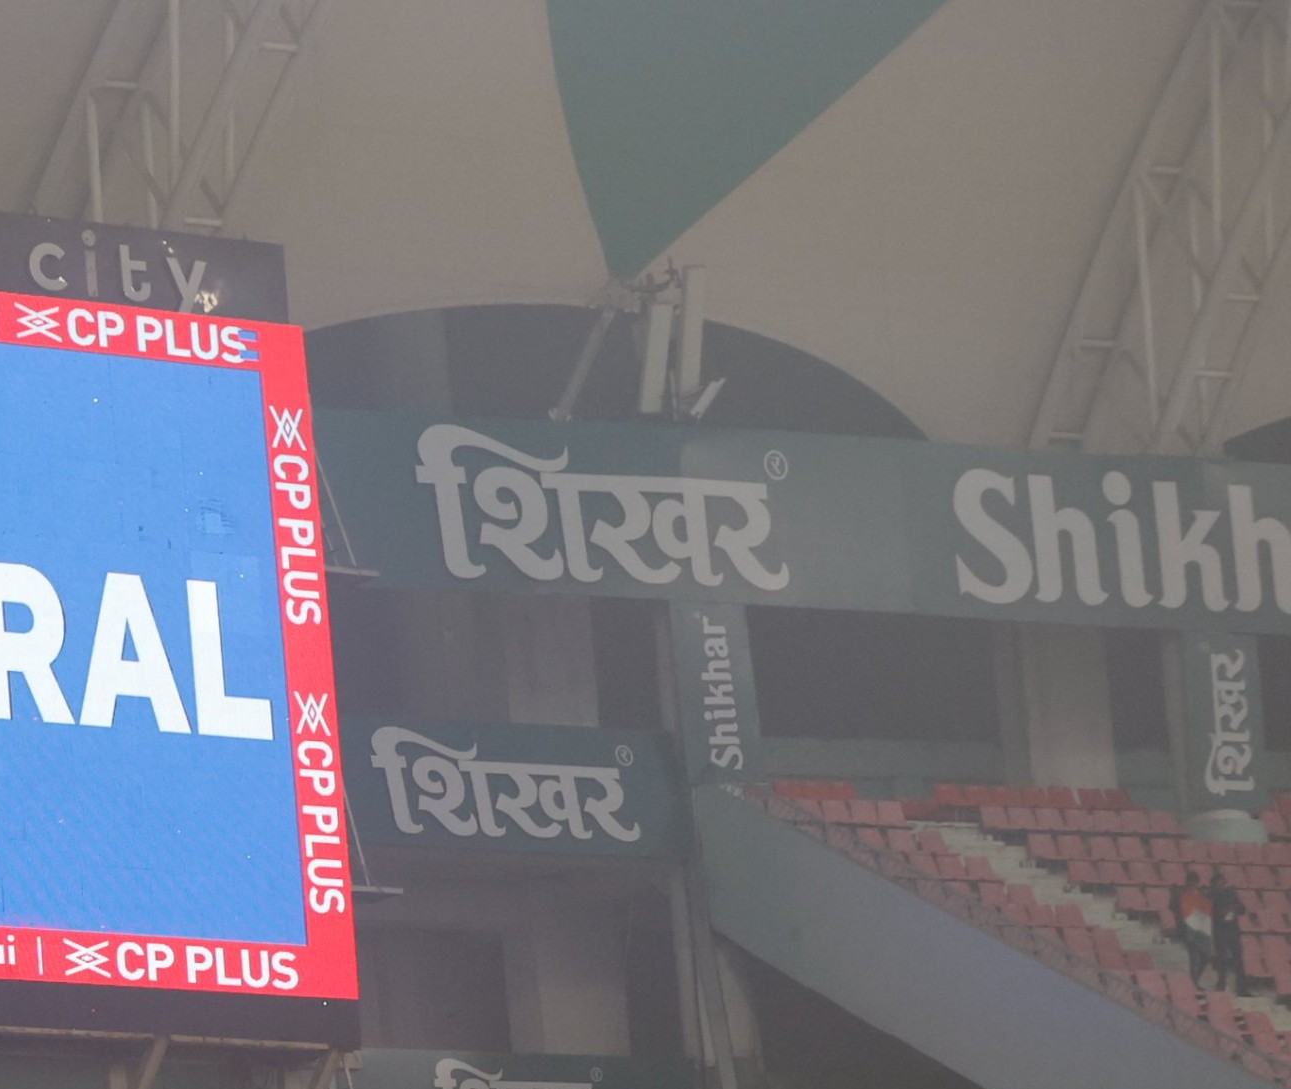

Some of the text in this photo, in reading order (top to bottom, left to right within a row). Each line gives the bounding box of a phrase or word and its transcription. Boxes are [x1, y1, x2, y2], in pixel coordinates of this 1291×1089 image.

[28, 229, 207, 313] city
[66, 306, 125, 348] CP
[137, 315, 252, 365] PLUS
[271, 454, 322, 628] CP PLUS
[414, 423, 790, 592] शिखर
[700, 614, 743, 771] Shikhar
[295, 738, 347, 916] CP PLUS
[370, 726, 642, 843] शिखर
[117, 942, 174, 983] CP
[186, 945, 300, 991] PLUS
